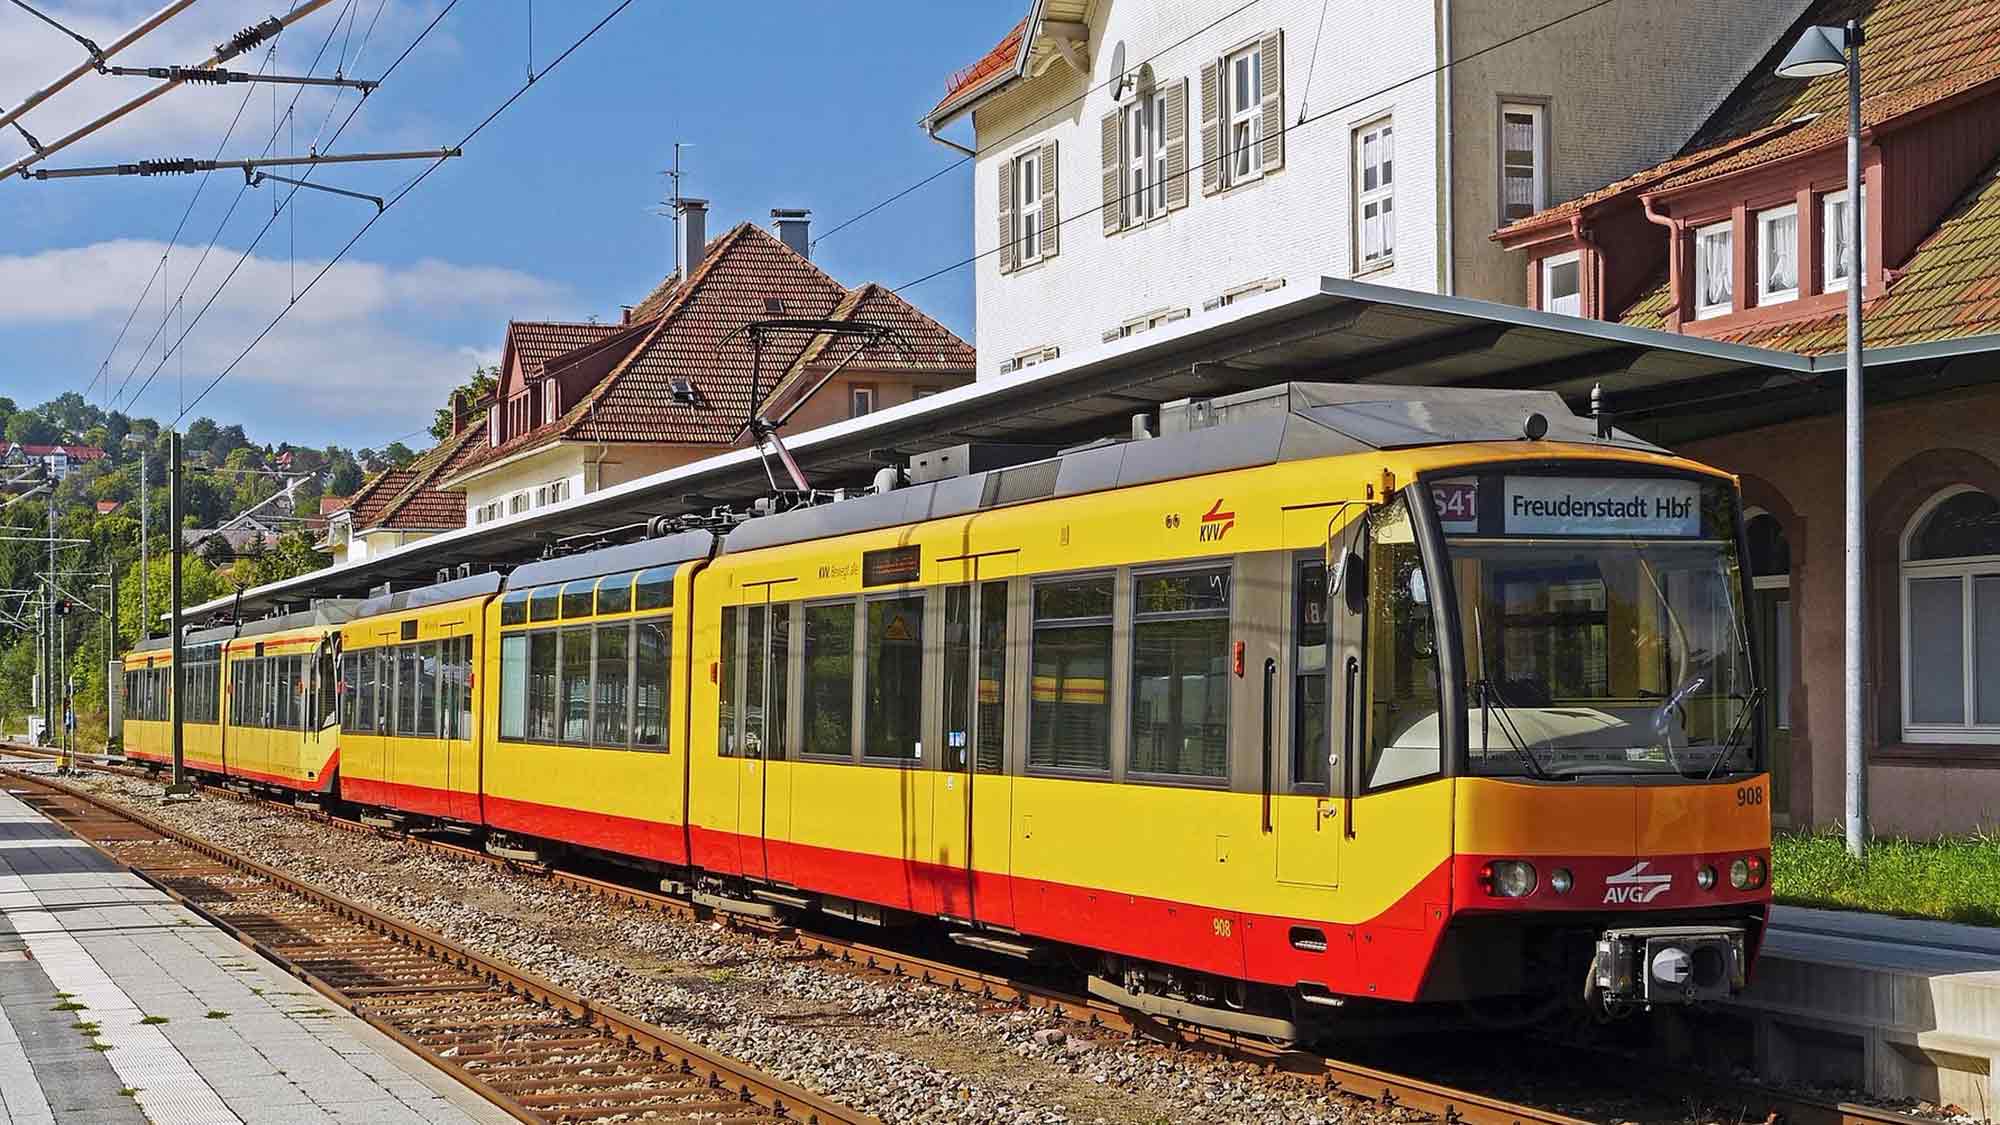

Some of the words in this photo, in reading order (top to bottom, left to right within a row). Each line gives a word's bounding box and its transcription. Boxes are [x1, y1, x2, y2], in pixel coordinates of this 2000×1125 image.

[1432, 489, 1475, 516] S41
[1512, 495, 1647, 518] Freudenstadt
[1656, 497, 1692, 519] Hbf
[1200, 523, 1219, 542] KVV
[1737, 786, 1762, 807] 908
[1602, 886, 1644, 904] AVG
[1213, 917, 1232, 937] 908
